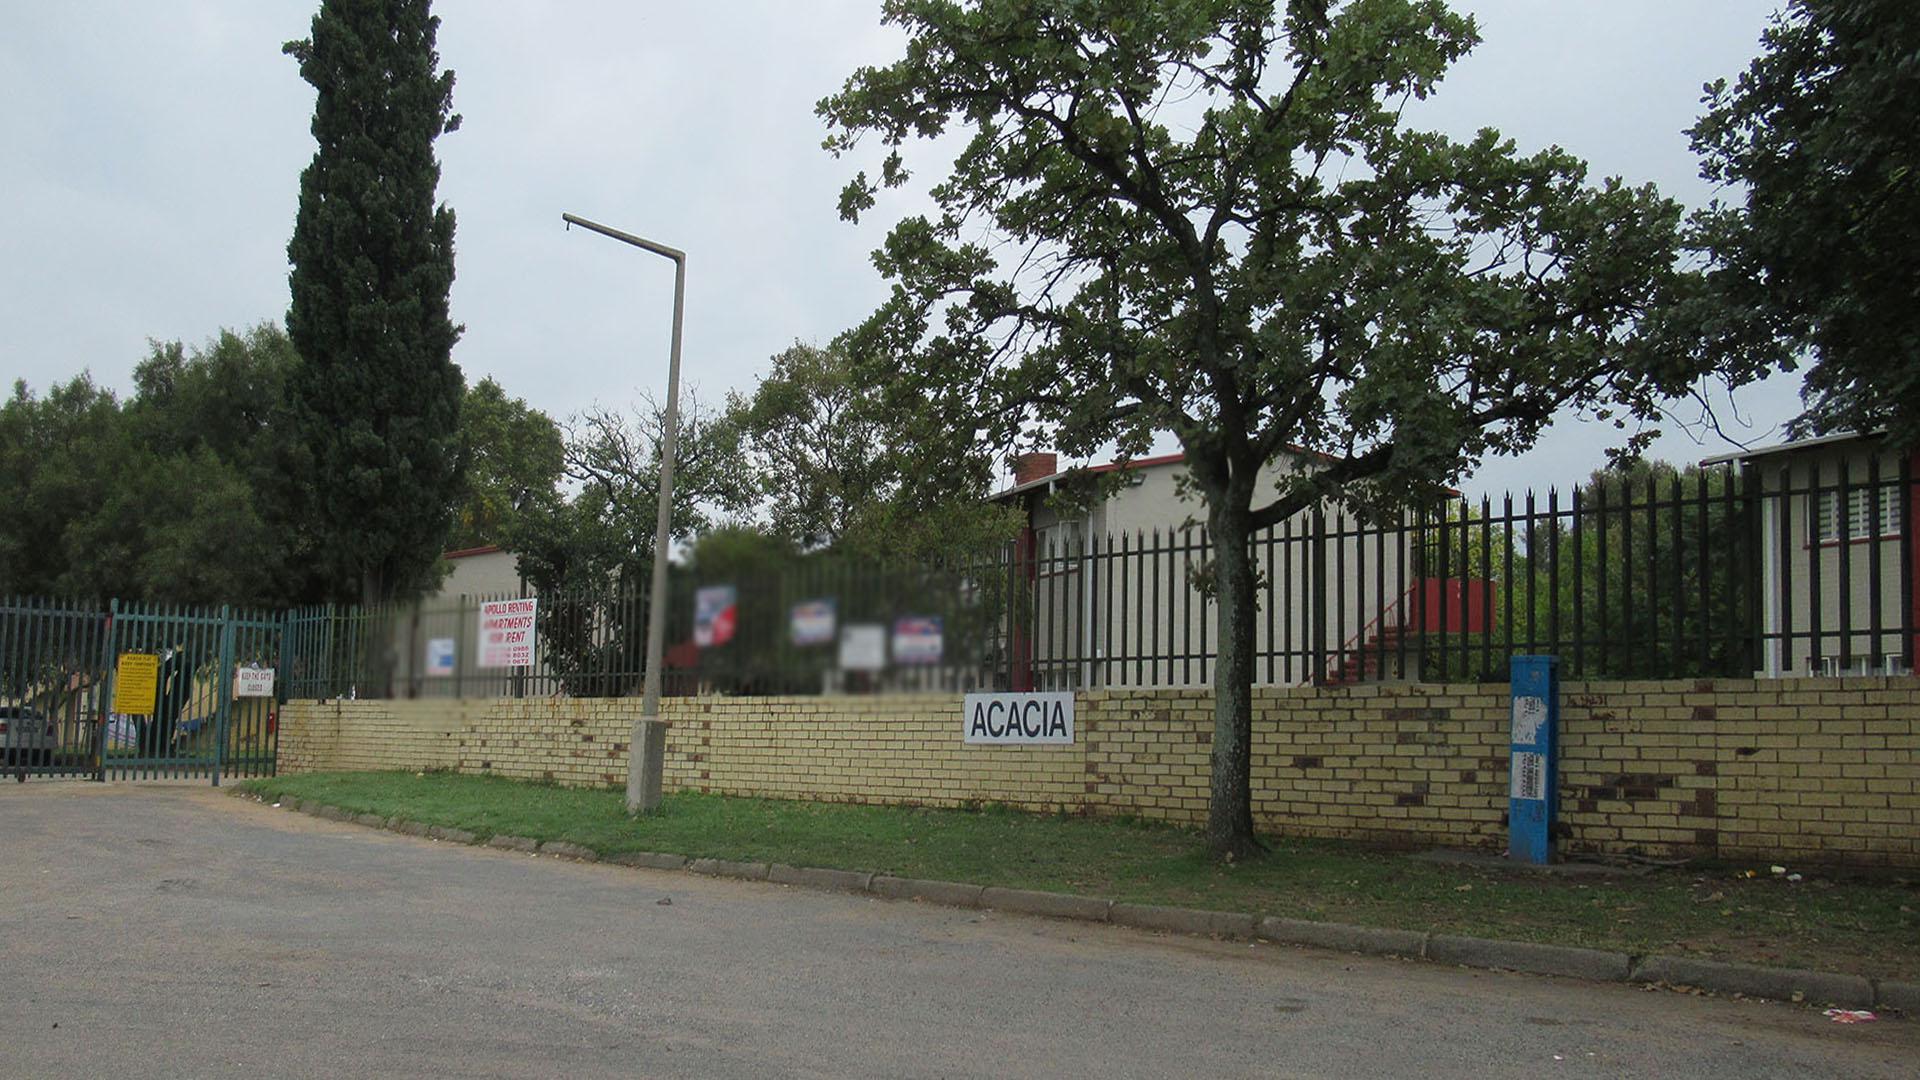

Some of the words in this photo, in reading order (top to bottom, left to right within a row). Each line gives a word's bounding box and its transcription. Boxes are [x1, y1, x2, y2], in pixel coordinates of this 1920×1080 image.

[508, 601, 533, 613] RENTING
[484, 616, 532, 630] ARTMENTS
[971, 700, 1067, 737] ACACIA
